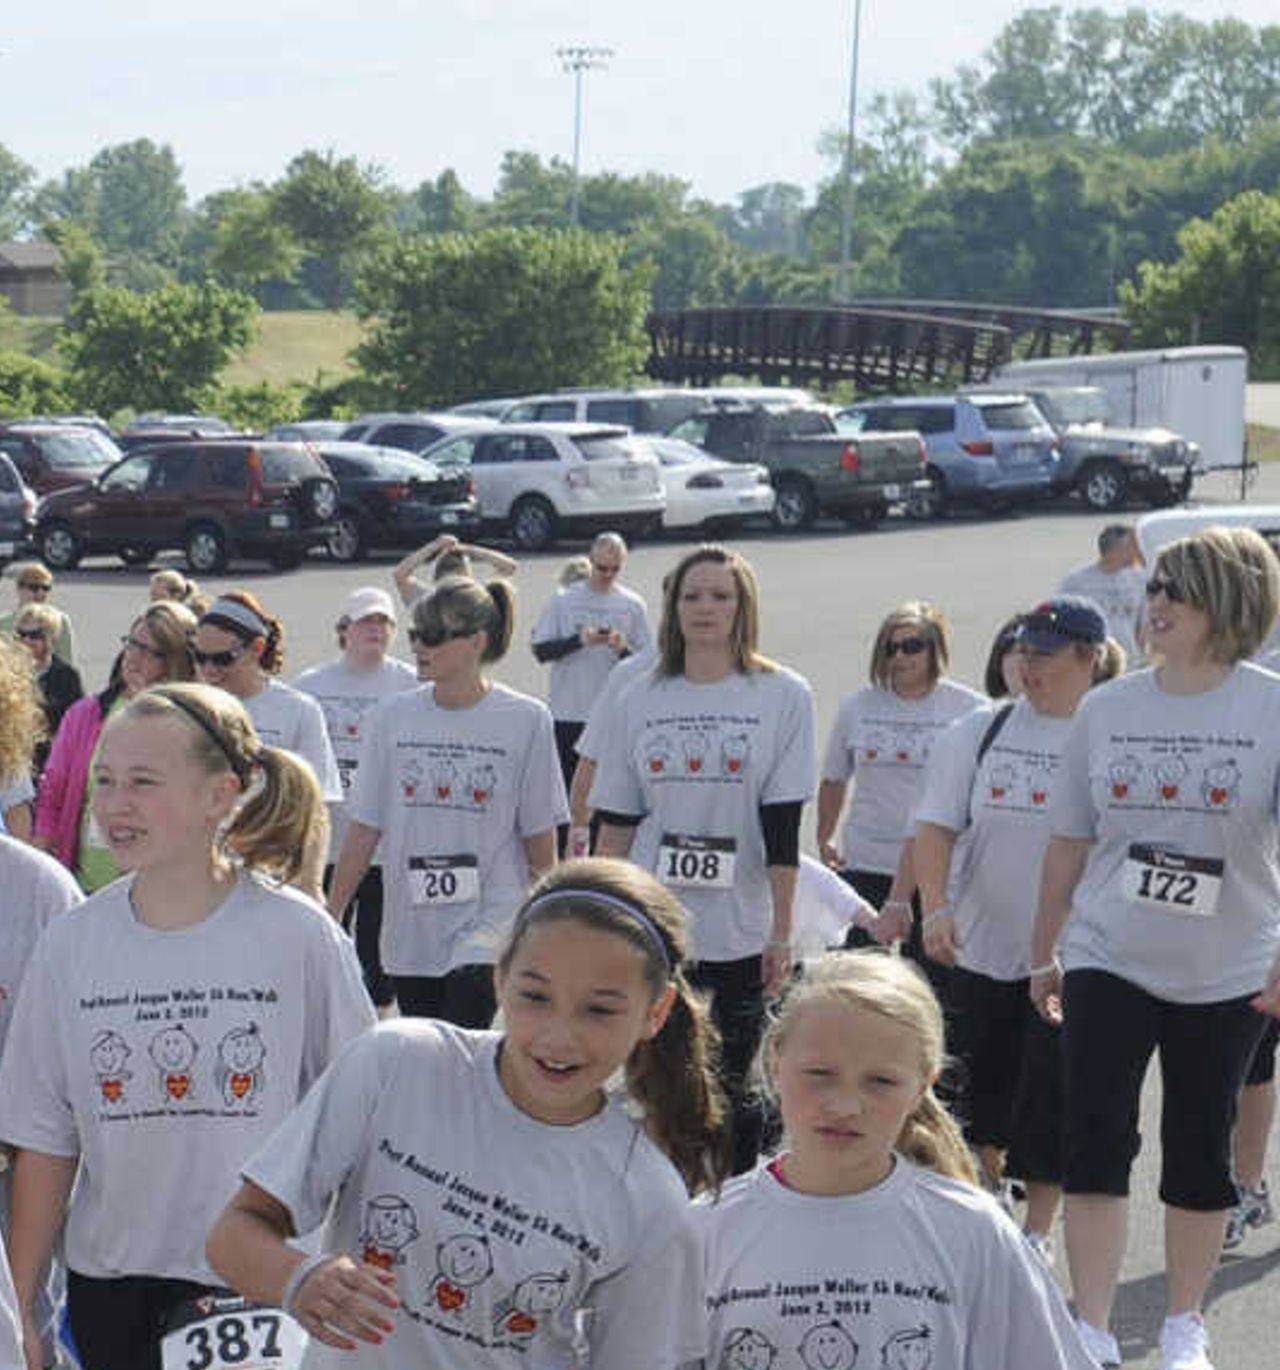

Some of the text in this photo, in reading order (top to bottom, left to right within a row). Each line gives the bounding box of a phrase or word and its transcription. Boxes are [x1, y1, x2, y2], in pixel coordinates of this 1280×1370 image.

[667, 853, 720, 880] 108
[424, 872, 456, 898] 20
[1138, 868, 1198, 906] 172
[442, 1198, 472, 1220] June
[775, 1278, 820, 1299] Jacque
[824, 1277, 869, 1295] Waller
[781, 1301, 811, 1317] June
[835, 1301, 872, 1315] 2012
